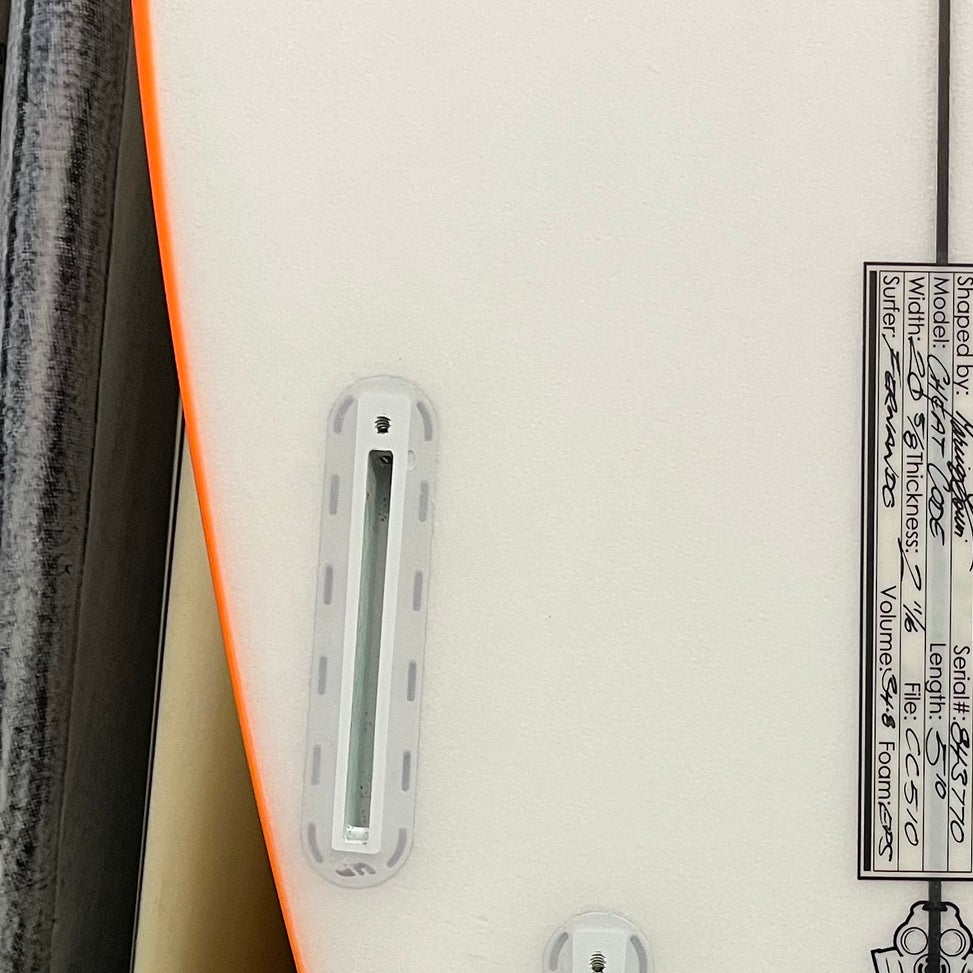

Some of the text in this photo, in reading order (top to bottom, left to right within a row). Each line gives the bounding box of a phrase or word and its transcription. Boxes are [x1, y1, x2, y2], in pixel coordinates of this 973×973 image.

[908, 277, 924, 341] Width:
[954, 276, 973, 357] Shaped
[882, 276, 901, 508] Surfer: FERNANDO
[908, 336, 925, 400] 20
[954, 364, 973, 395] by:
[928, 277, 950, 546] Model: CHEAT CODE
[906, 452, 923, 553] Thickness:
[880, 586, 897, 671] Volume:
[925, 644, 946, 720] Length:
[878, 742, 895, 805] Foam:
[904, 682, 921, 846] File: CC510
[950, 646, 970, 843] Serial#: 843770
